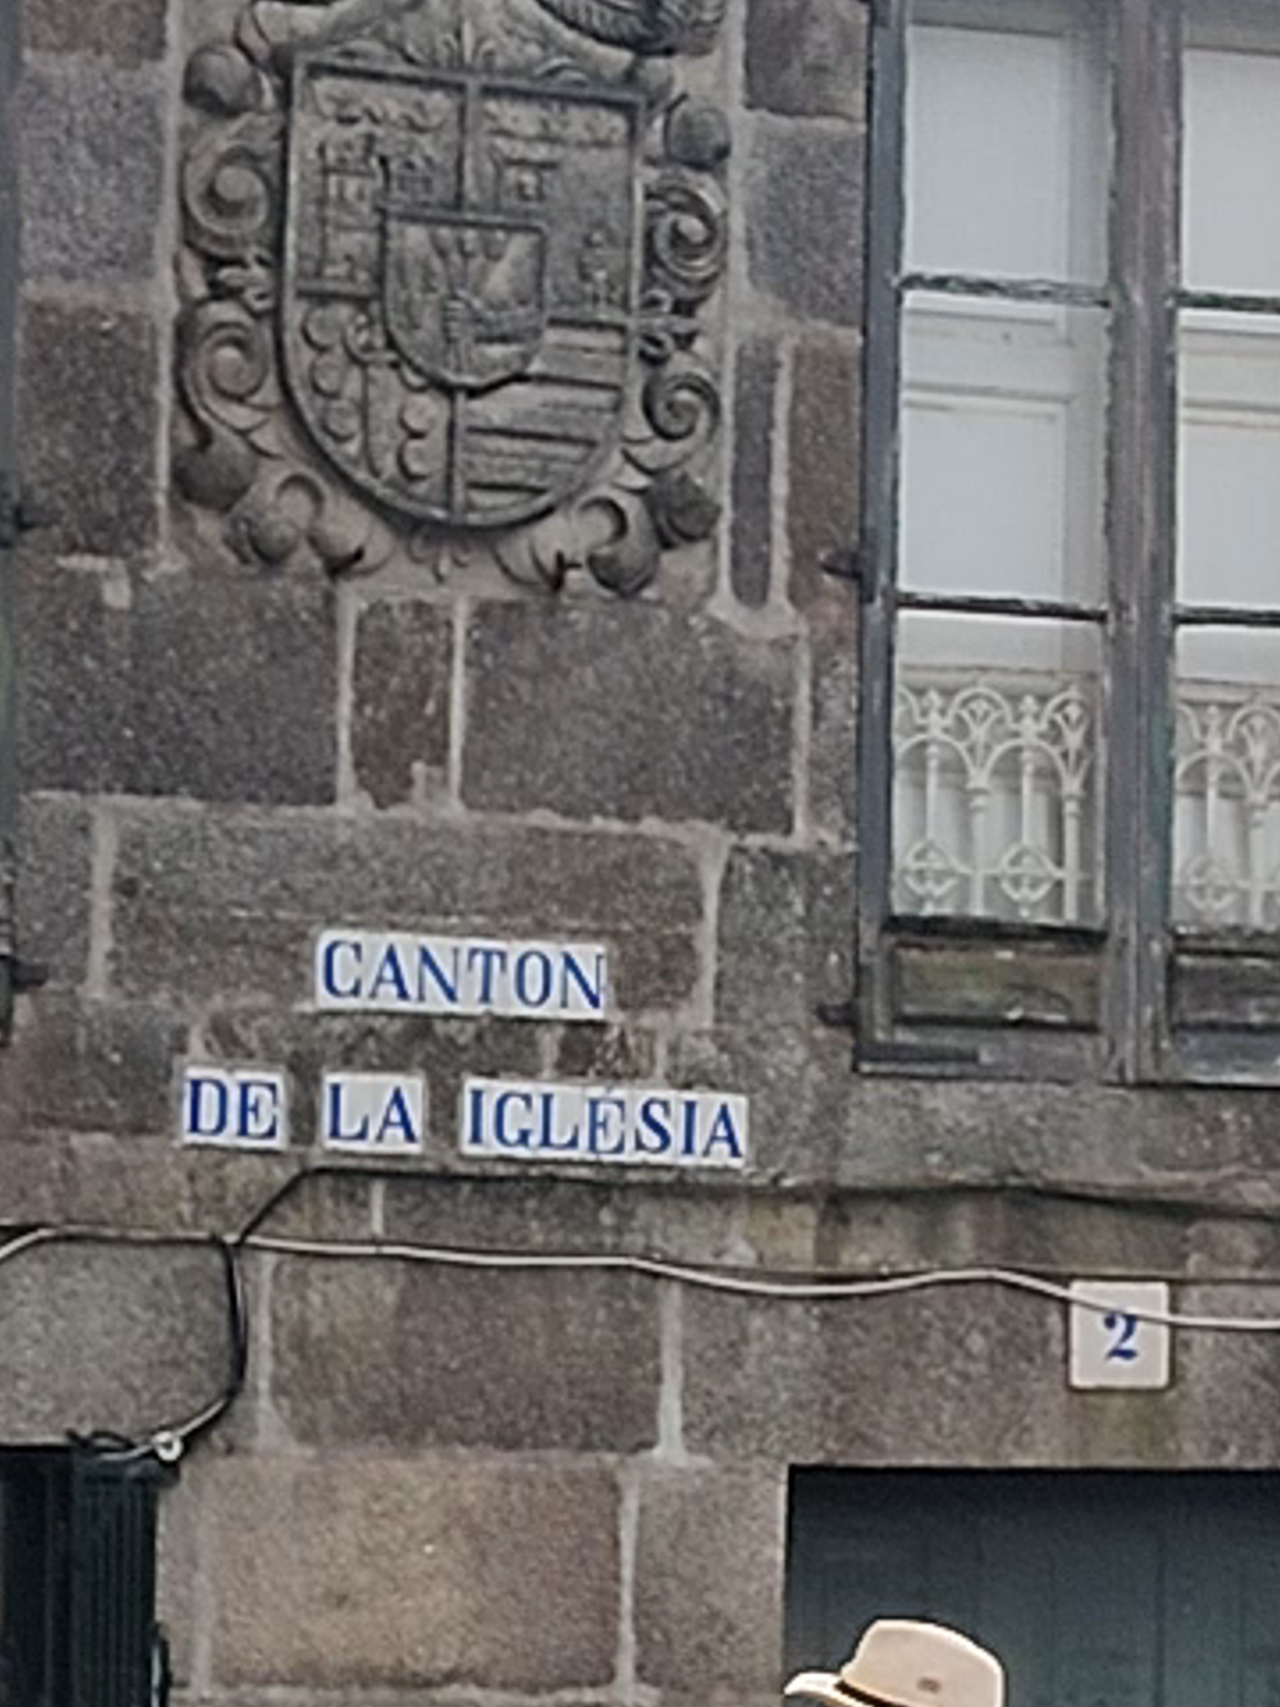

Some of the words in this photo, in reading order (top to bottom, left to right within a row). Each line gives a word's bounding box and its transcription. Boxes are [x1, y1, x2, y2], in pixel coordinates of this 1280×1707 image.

[322, 939, 606, 1011] CANTON
[187, 1078, 278, 1141] DE
[328, 1082, 418, 1145] LA
[468, 1089, 743, 1159] IGLESIA
[1103, 1311, 1138, 1362] 2
